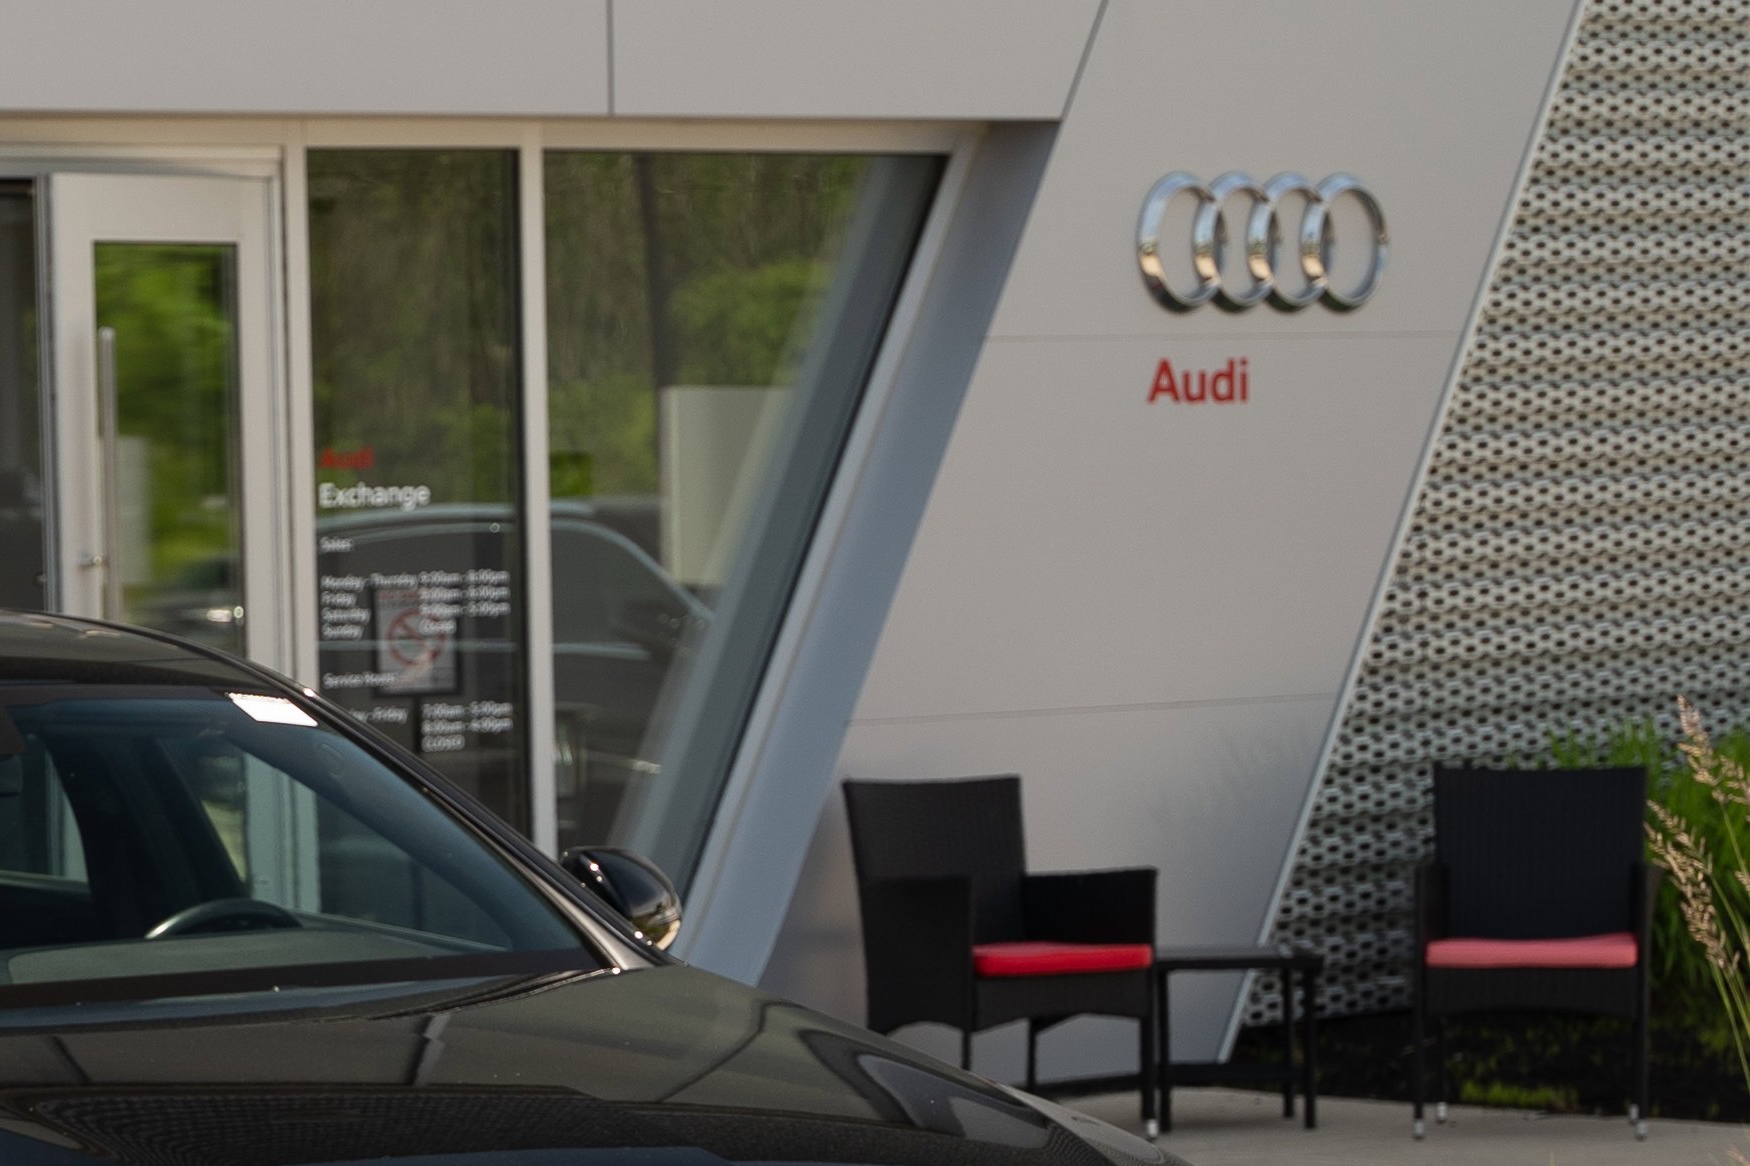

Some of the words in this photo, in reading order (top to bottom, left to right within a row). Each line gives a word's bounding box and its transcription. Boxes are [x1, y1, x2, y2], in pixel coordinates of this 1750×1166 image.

[1149, 357, 1250, 403] Audi
[318, 482, 431, 511] Exchange
[321, 575, 363, 591] Monday
[371, 573, 417, 589] Thursday
[322, 592, 356, 607] Friday
[322, 607, 371, 623] Saturday
[323, 624, 363, 639] Sunday
[323, 672, 362, 688] Service
[374, 707, 407, 723] Friday
